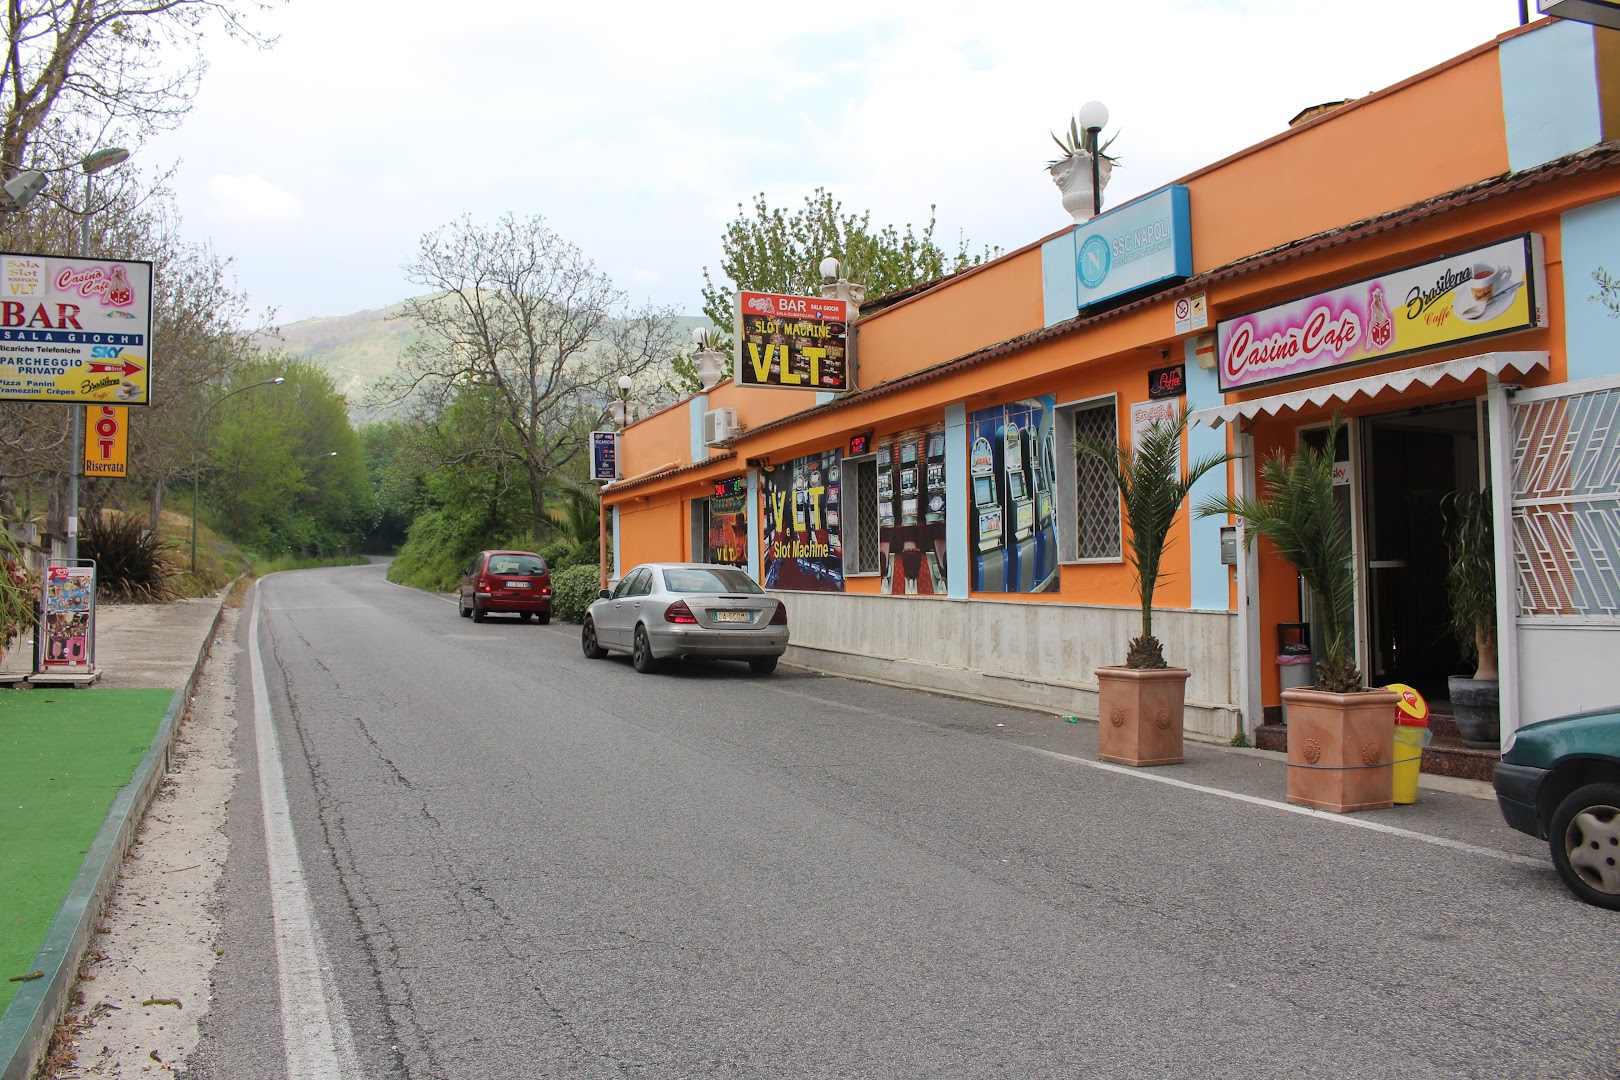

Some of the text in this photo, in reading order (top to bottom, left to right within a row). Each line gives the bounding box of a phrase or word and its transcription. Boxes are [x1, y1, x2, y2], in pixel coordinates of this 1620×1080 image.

[1112, 217, 1170, 257] SSC NAPOLI
[7, 260, 40, 268] Sala
[9, 269, 37, 277] Slot
[9, 283, 37, 295] VLT
[1405, 267, 1474, 320] Brasilena
[779, 299, 807, 313] BAR
[0, 301, 83, 330] BAR
[755, 320, 832, 338] SLOT MACHINE
[4, 331, 139, 344] SALA GIOCHI
[37, 346, 81, 354] Telefoniche
[90, 345, 125, 359] SKY
[0, 357, 82, 367] PARCHEGGIO
[748, 342, 826, 386] VLT
[18, 367, 65, 375] PRIVATO
[86, 460, 124, 472] Riservata
[786, 527, 790, 537] e
[774, 540, 829, 558] Slot Machine
